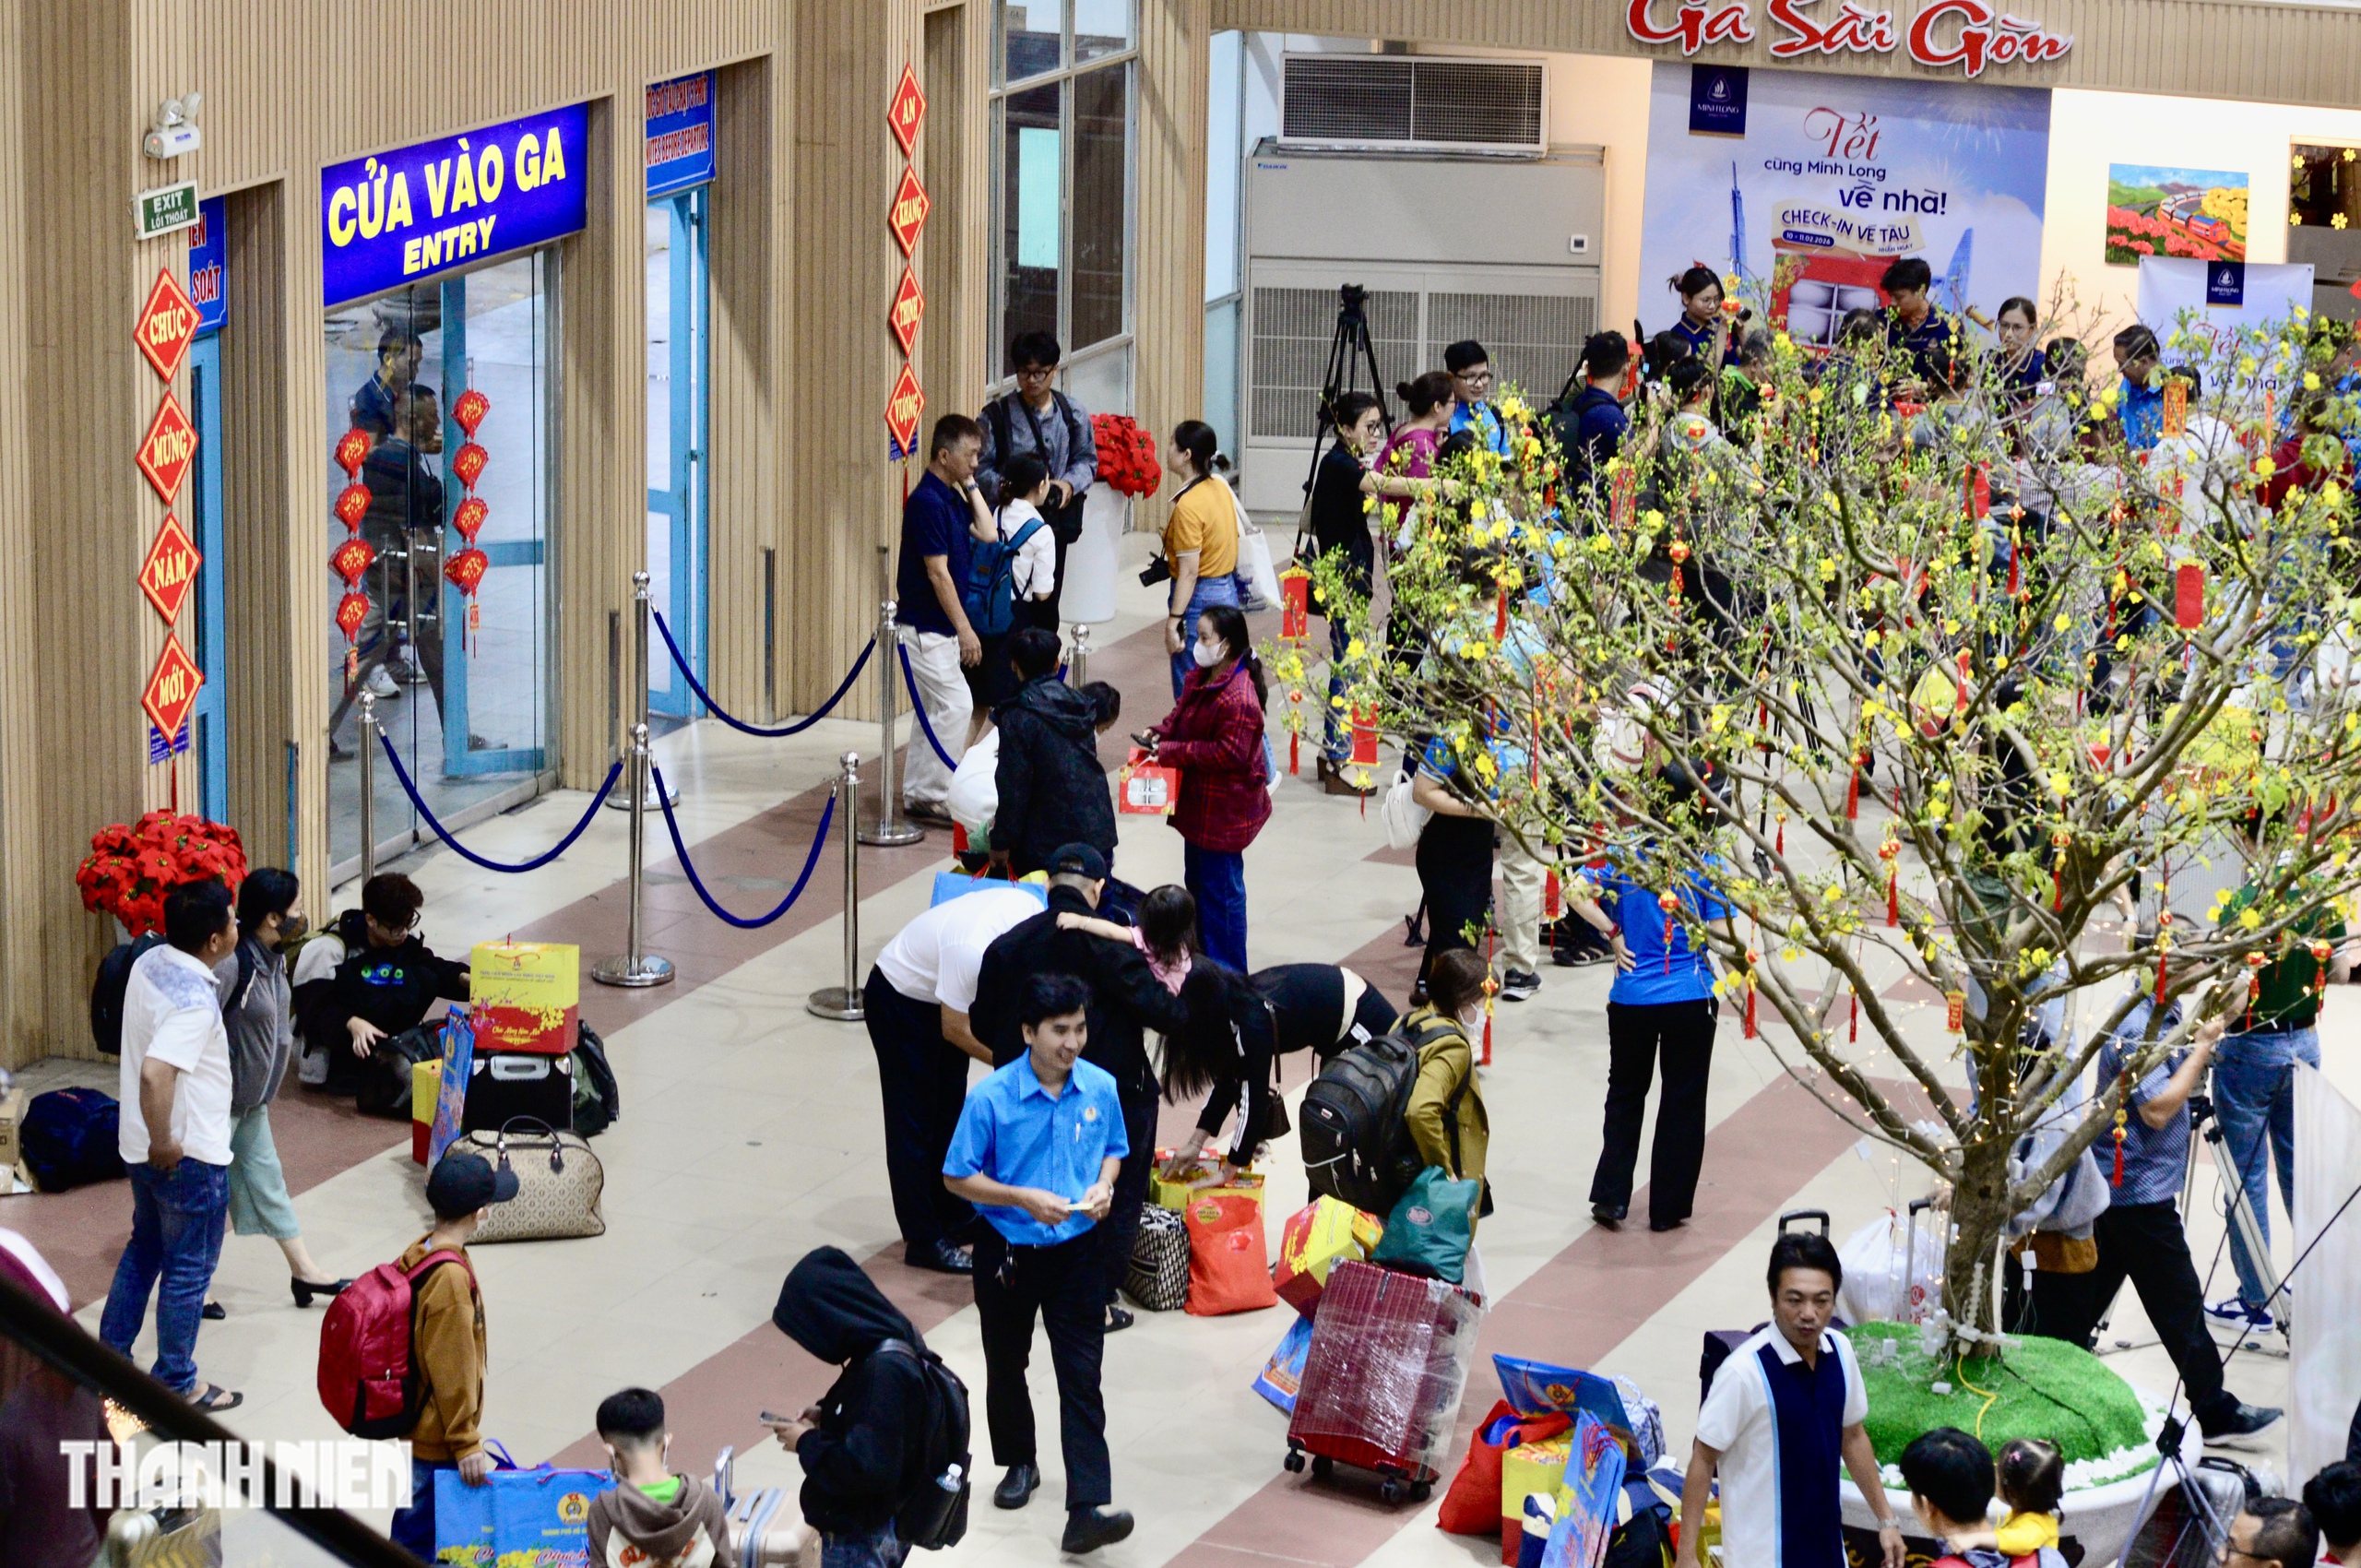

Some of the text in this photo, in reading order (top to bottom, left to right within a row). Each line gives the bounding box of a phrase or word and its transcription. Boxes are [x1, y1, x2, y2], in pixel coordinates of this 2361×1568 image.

[1627, 0, 2073, 77] Ga Sài Gòn
[902, 95, 917, 125] AN
[1804, 106, 1882, 160] Tết
[328, 126, 566, 247] CỬA VÀO GA
[1764, 157, 1886, 181] cũng Minh Long
[153, 191, 184, 213] EXIT
[165, 207, 188, 225] THOÁT
[898, 195, 922, 229] KHANG
[1839, 179, 1947, 215] về nhà!
[1782, 209, 1853, 236] CHECK-IN
[403, 214, 496, 275] ENTRY
[192, 259, 221, 306] SOÁT
[149, 300, 186, 346] CHÚC
[899, 296, 919, 330] THỊNH
[894, 391, 919, 427] VƯỢNG
[153, 424, 187, 469] MỪNG
[154, 545, 186, 591] NĂM
[158, 664, 186, 708] MỚI
